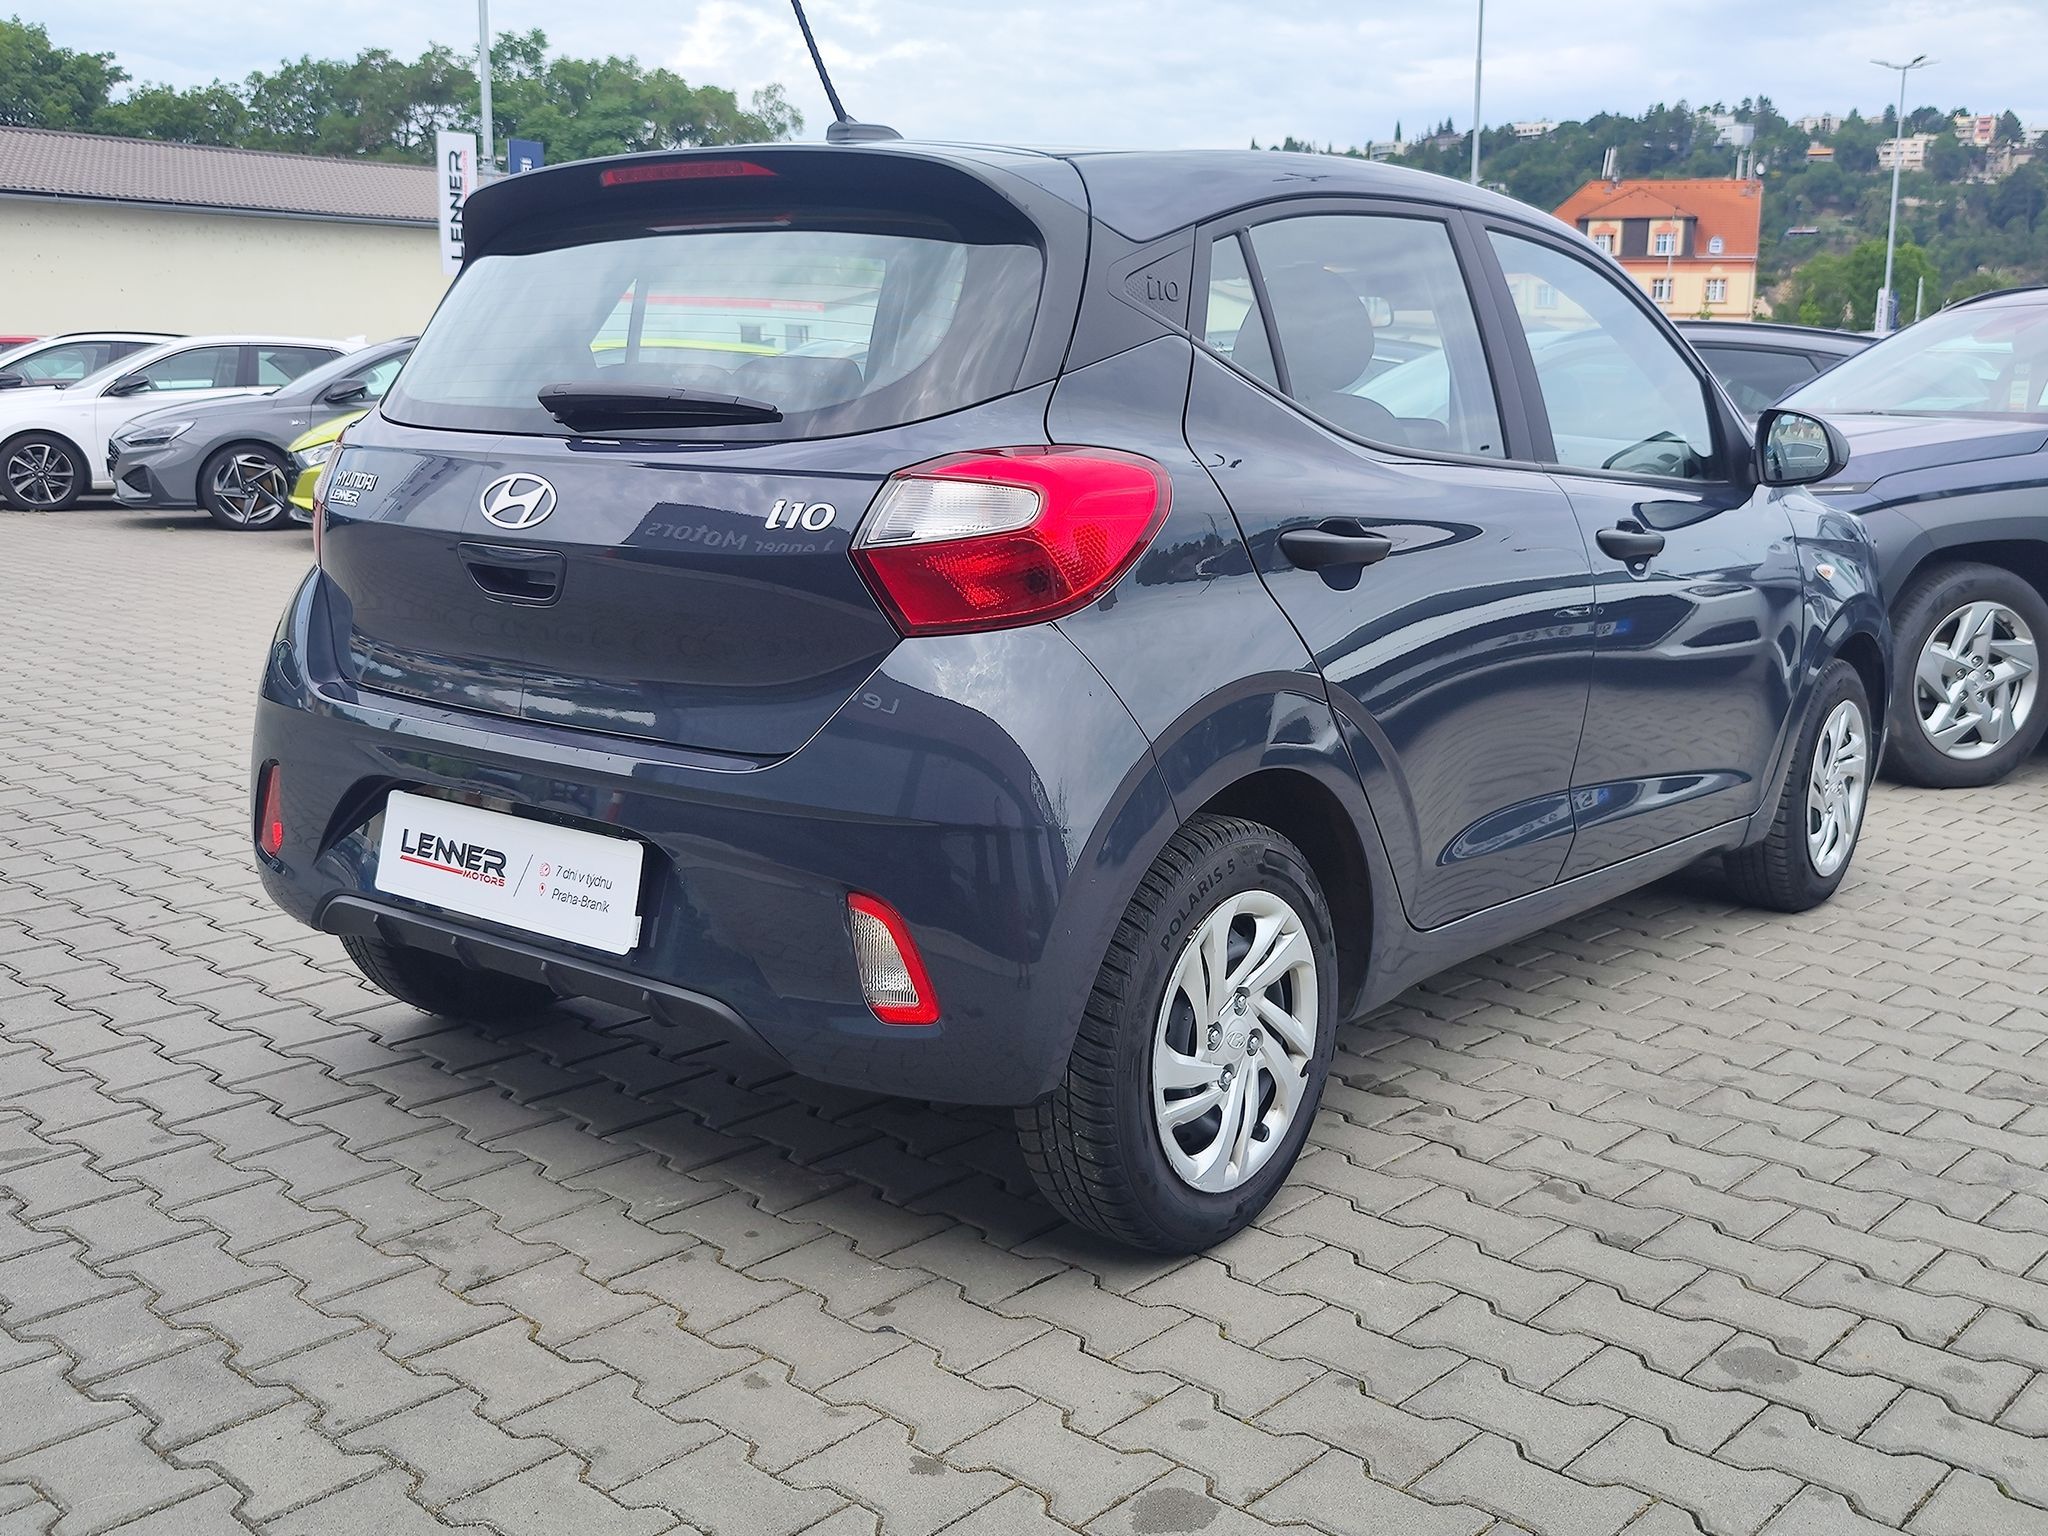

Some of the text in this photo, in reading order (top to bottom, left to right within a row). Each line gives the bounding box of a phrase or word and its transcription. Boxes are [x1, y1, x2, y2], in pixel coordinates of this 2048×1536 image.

[449, 150, 465, 260] LENNER
[1147, 275, 1180, 302] i10
[330, 488, 361, 502] LENNER
[336, 471, 378, 492] HYUNDAI
[765, 499, 837, 531] i10
[400, 828, 507, 878] LENNER
[462, 870, 506, 887] MOTORS
[556, 865, 563, 877] 7
[578, 873, 585, 882] v
[586, 873, 613, 890] týdnu
[1159, 858, 1236, 952] POLARIS 5
